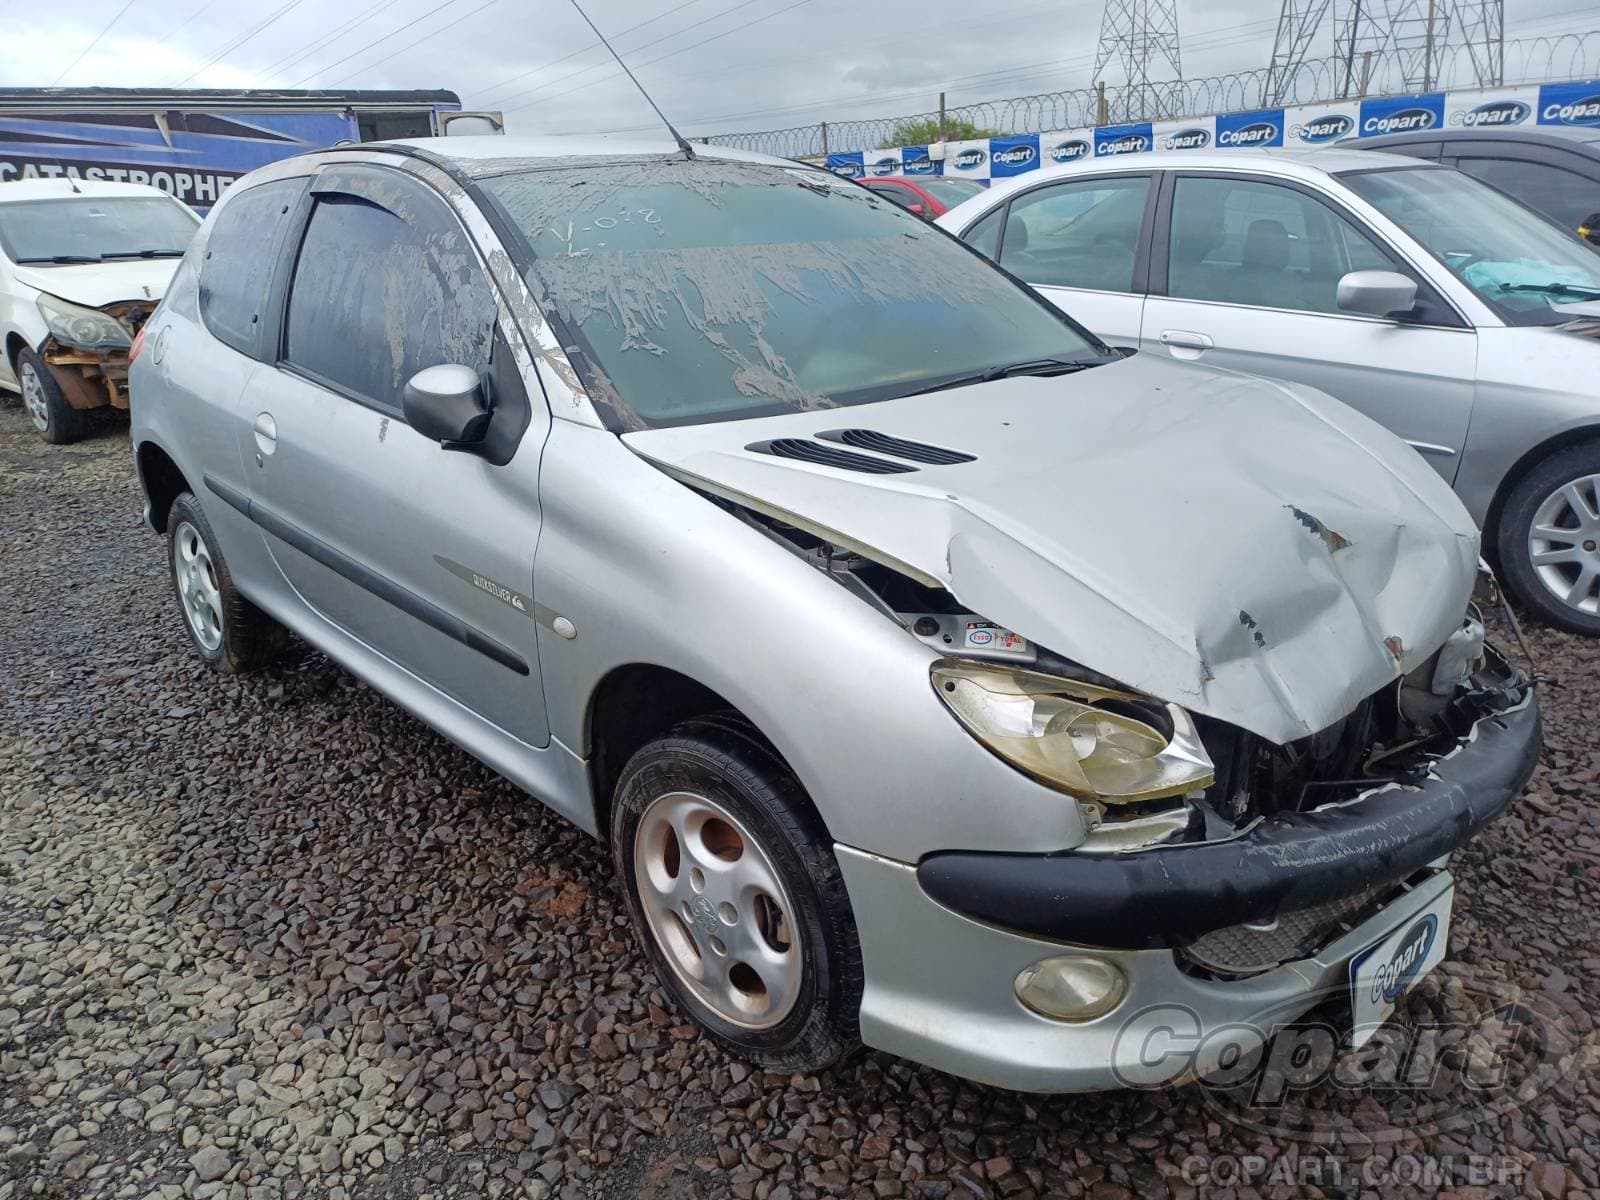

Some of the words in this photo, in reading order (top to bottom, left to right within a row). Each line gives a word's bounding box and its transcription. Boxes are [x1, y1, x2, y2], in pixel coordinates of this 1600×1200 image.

[1450, 109, 1520, 127] Copart
[1543, 103, 1600, 120] Copa
[1288, 120, 1345, 139] Copart
[1364, 114, 1428, 133] Copart
[1220, 126, 1272, 144] Copart
[1098, 137, 1142, 154] Copart
[953, 153, 982, 166] opart
[993, 150, 1031, 164] Copart
[1001, 636, 1021, 644] TOTAL
[1371, 926, 1428, 1004] Copart
